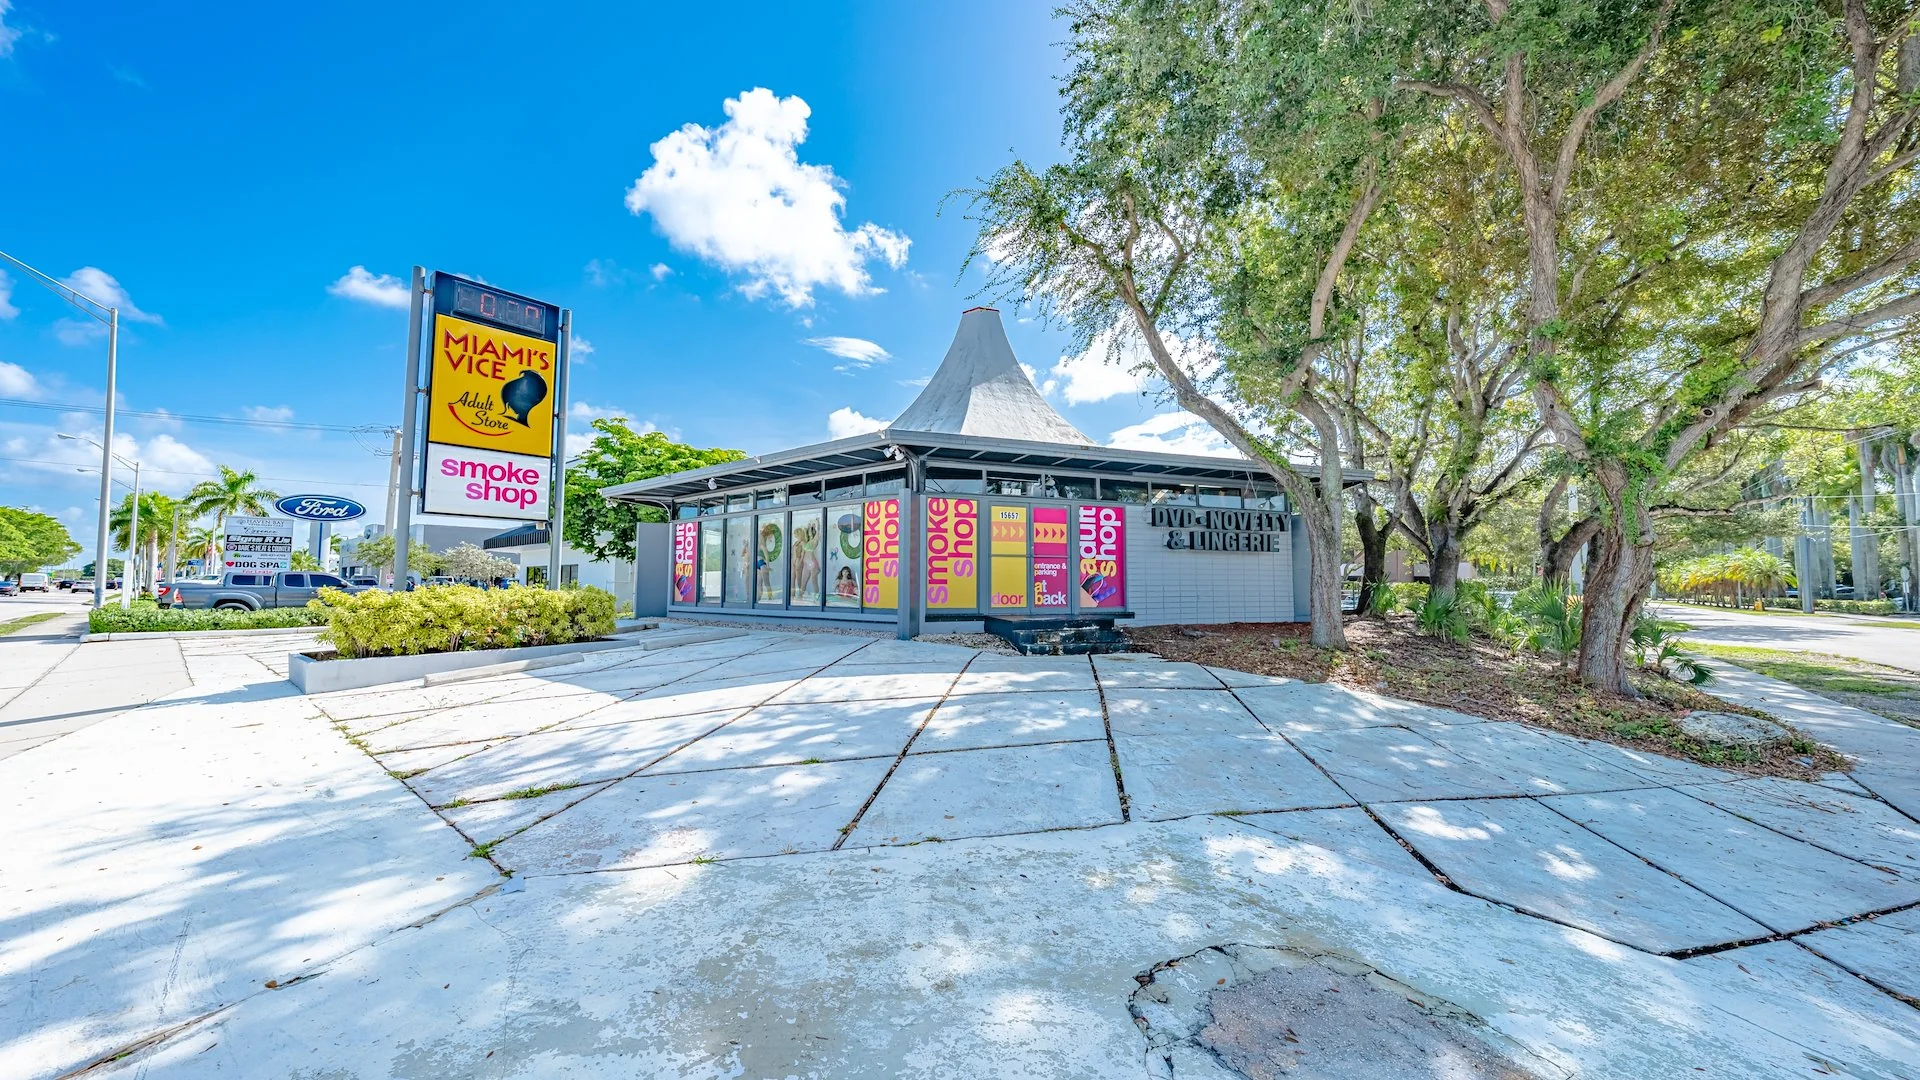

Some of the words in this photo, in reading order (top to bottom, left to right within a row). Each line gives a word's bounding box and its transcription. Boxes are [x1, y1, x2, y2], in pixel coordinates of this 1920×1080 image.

[444, 328, 549, 370] MIAMI'S
[444, 351, 505, 380] VICE
[449, 391, 494, 411] Adult
[471, 410, 509, 430] Store
[440, 458, 540, 485] smoke
[465, 480, 537, 509] shop
[295, 499, 350, 518] Ford
[1000, 511, 1019, 520] 15657
[1152, 507, 1196, 527] DVD
[1206, 510, 1291, 532] NOVELTY
[228, 535, 264, 543] Signs
[683, 523, 696, 578] shop
[879, 499, 899, 578] shop
[927, 498, 949, 604] smoke
[948, 499, 977, 578] shop
[1079, 506, 1097, 575] adult
[1096, 508, 1121, 578] shop
[1167, 530, 1185, 549] &
[1189, 531, 1280, 552] LINGERIE
[864, 501, 880, 605] smoke
[1034, 569, 1057, 577] parking
[991, 591, 1023, 605] door
[1034, 580, 1047, 593] at
[1034, 592, 1067, 605] back
